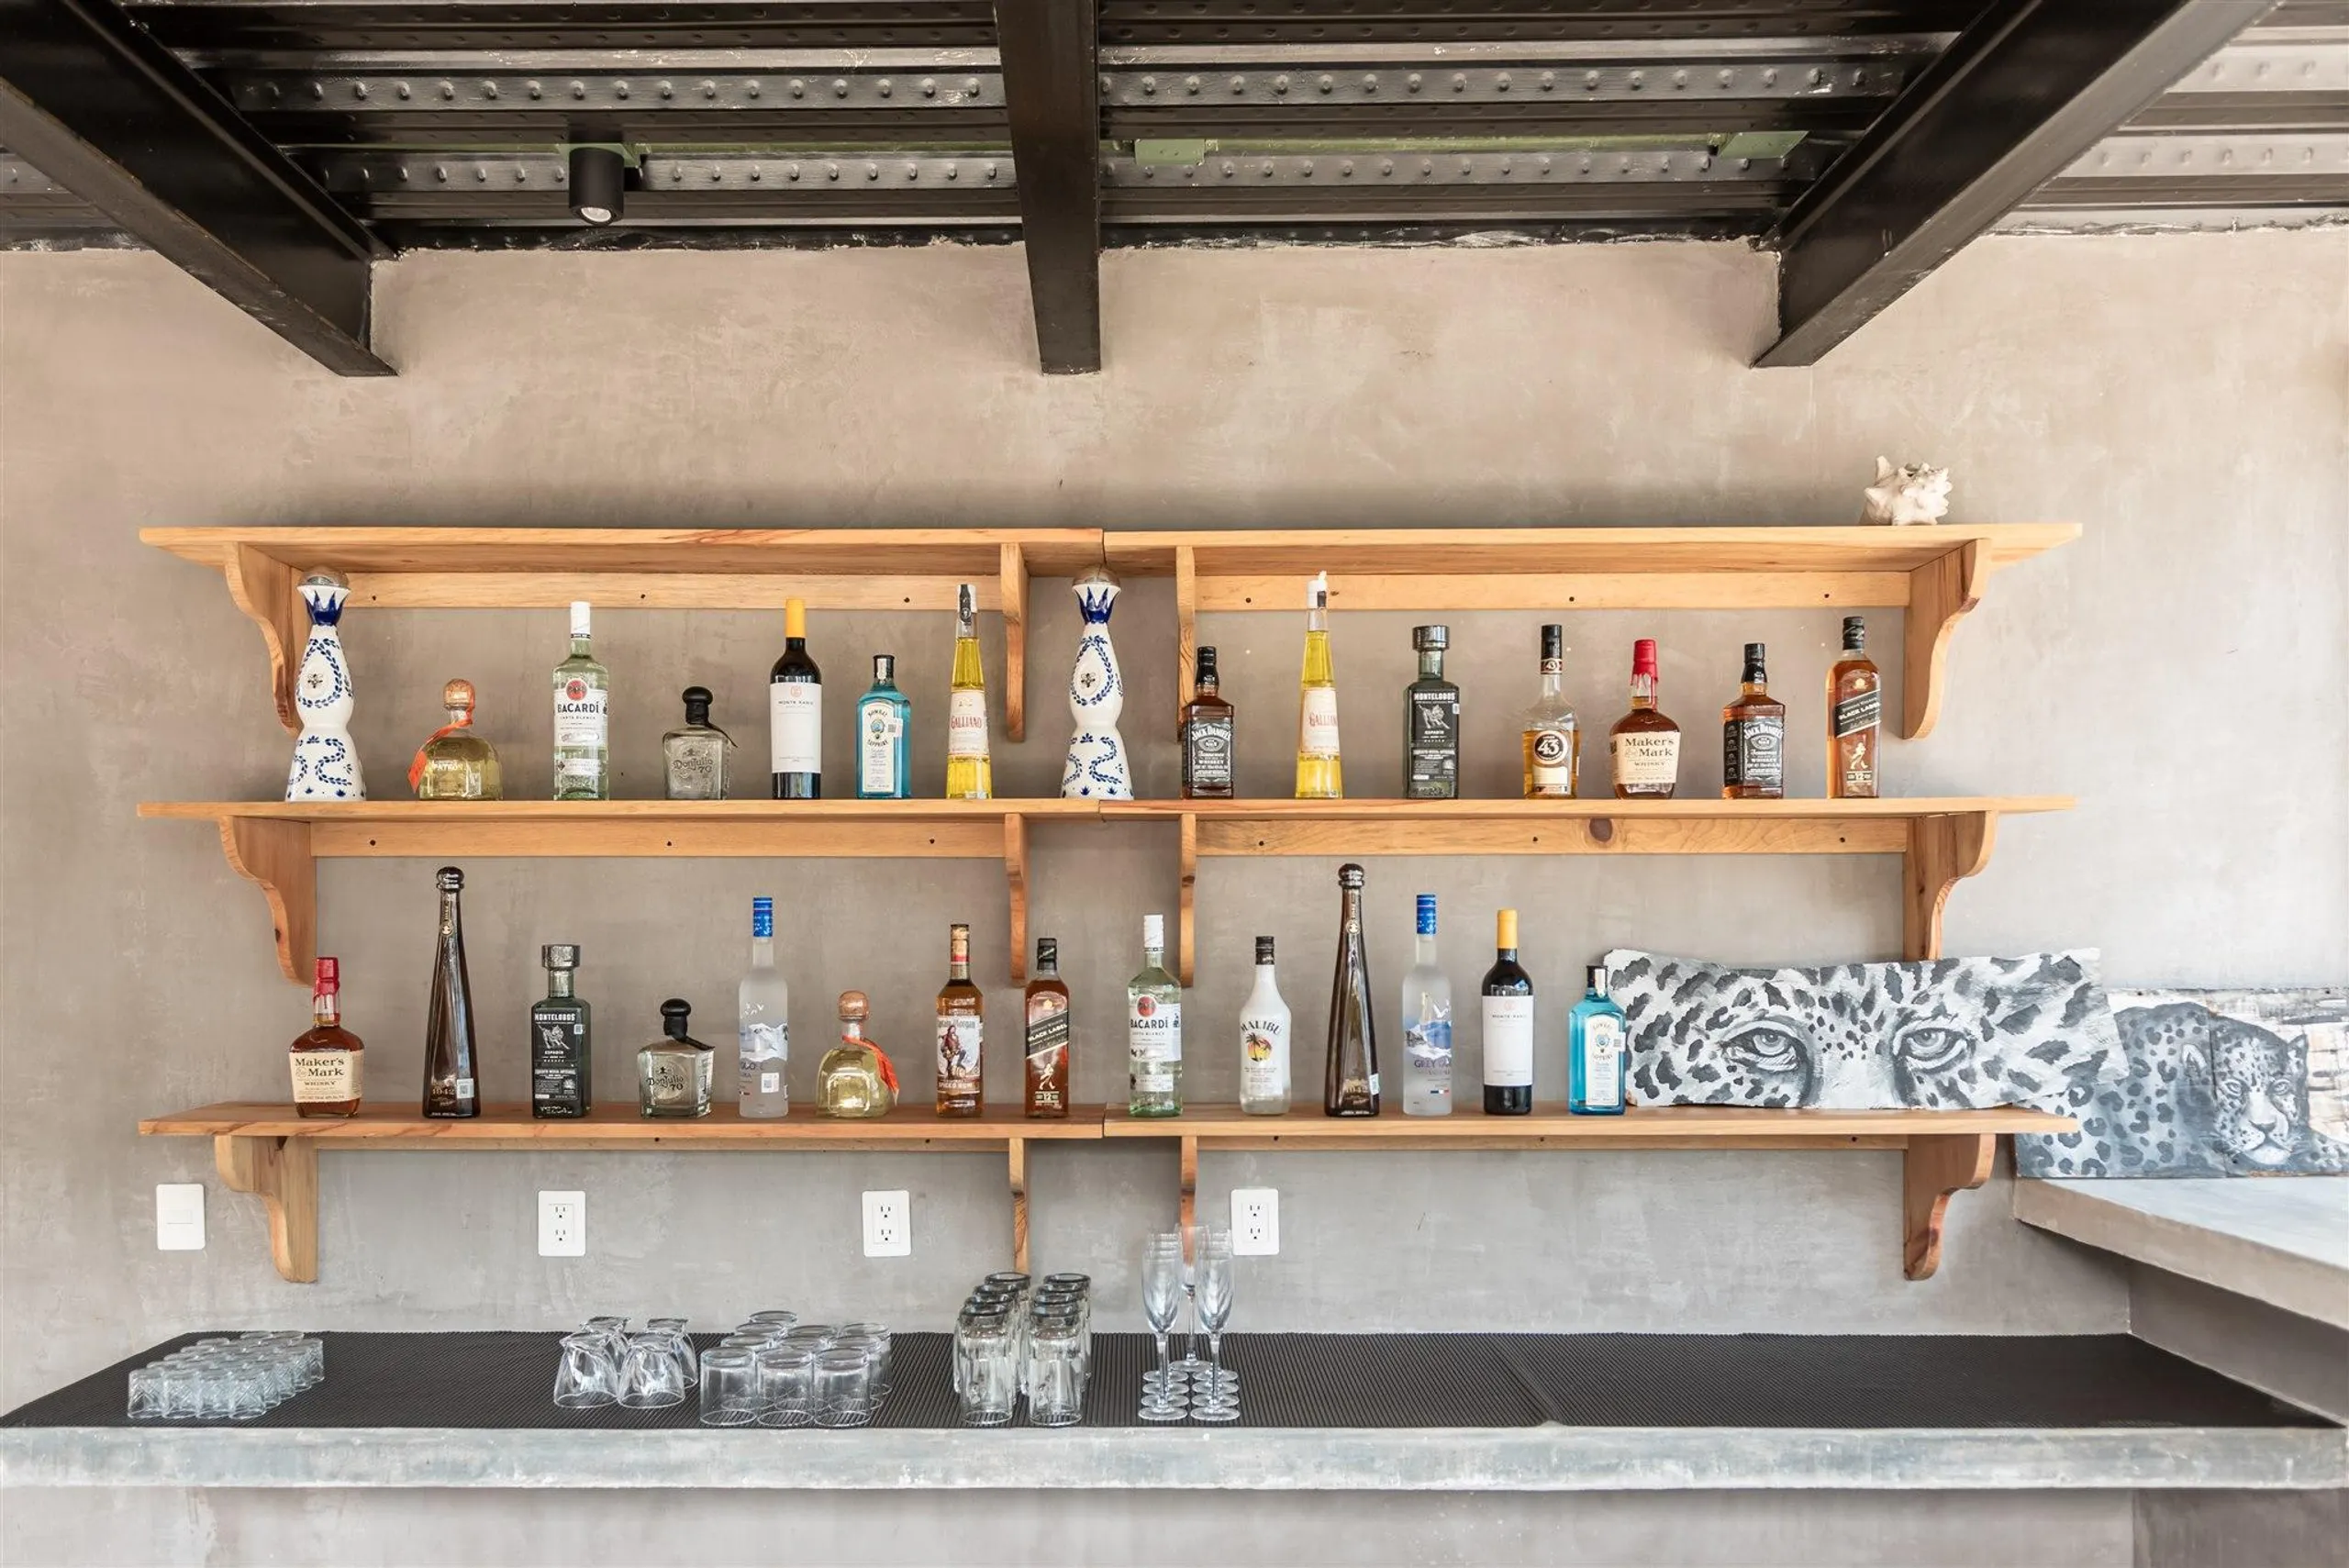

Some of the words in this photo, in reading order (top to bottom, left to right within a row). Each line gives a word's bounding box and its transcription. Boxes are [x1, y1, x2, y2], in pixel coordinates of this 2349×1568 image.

[557, 702, 599, 713] BACARDÍ
[1838, 708, 1860, 721] BLACK
[1861, 702, 1880, 714] LABEL
[951, 716, 982, 729] GALLIANO
[1192, 728, 1208, 741] JACK
[1743, 726, 1760, 740] JACK
[1538, 739, 1560, 755] 43
[1625, 738, 1674, 747] Maker's
[1639, 748, 1673, 757] Mark
[535, 1013, 575, 1021] MONTELOBOS
[1028, 1030, 1048, 1041] BLACK
[1048, 1023, 1068, 1034] LABEL
[1241, 1020, 1283, 1035] MALIBU
[295, 1058, 345, 1066] Maker's
[308, 1068, 345, 1077] Mark
